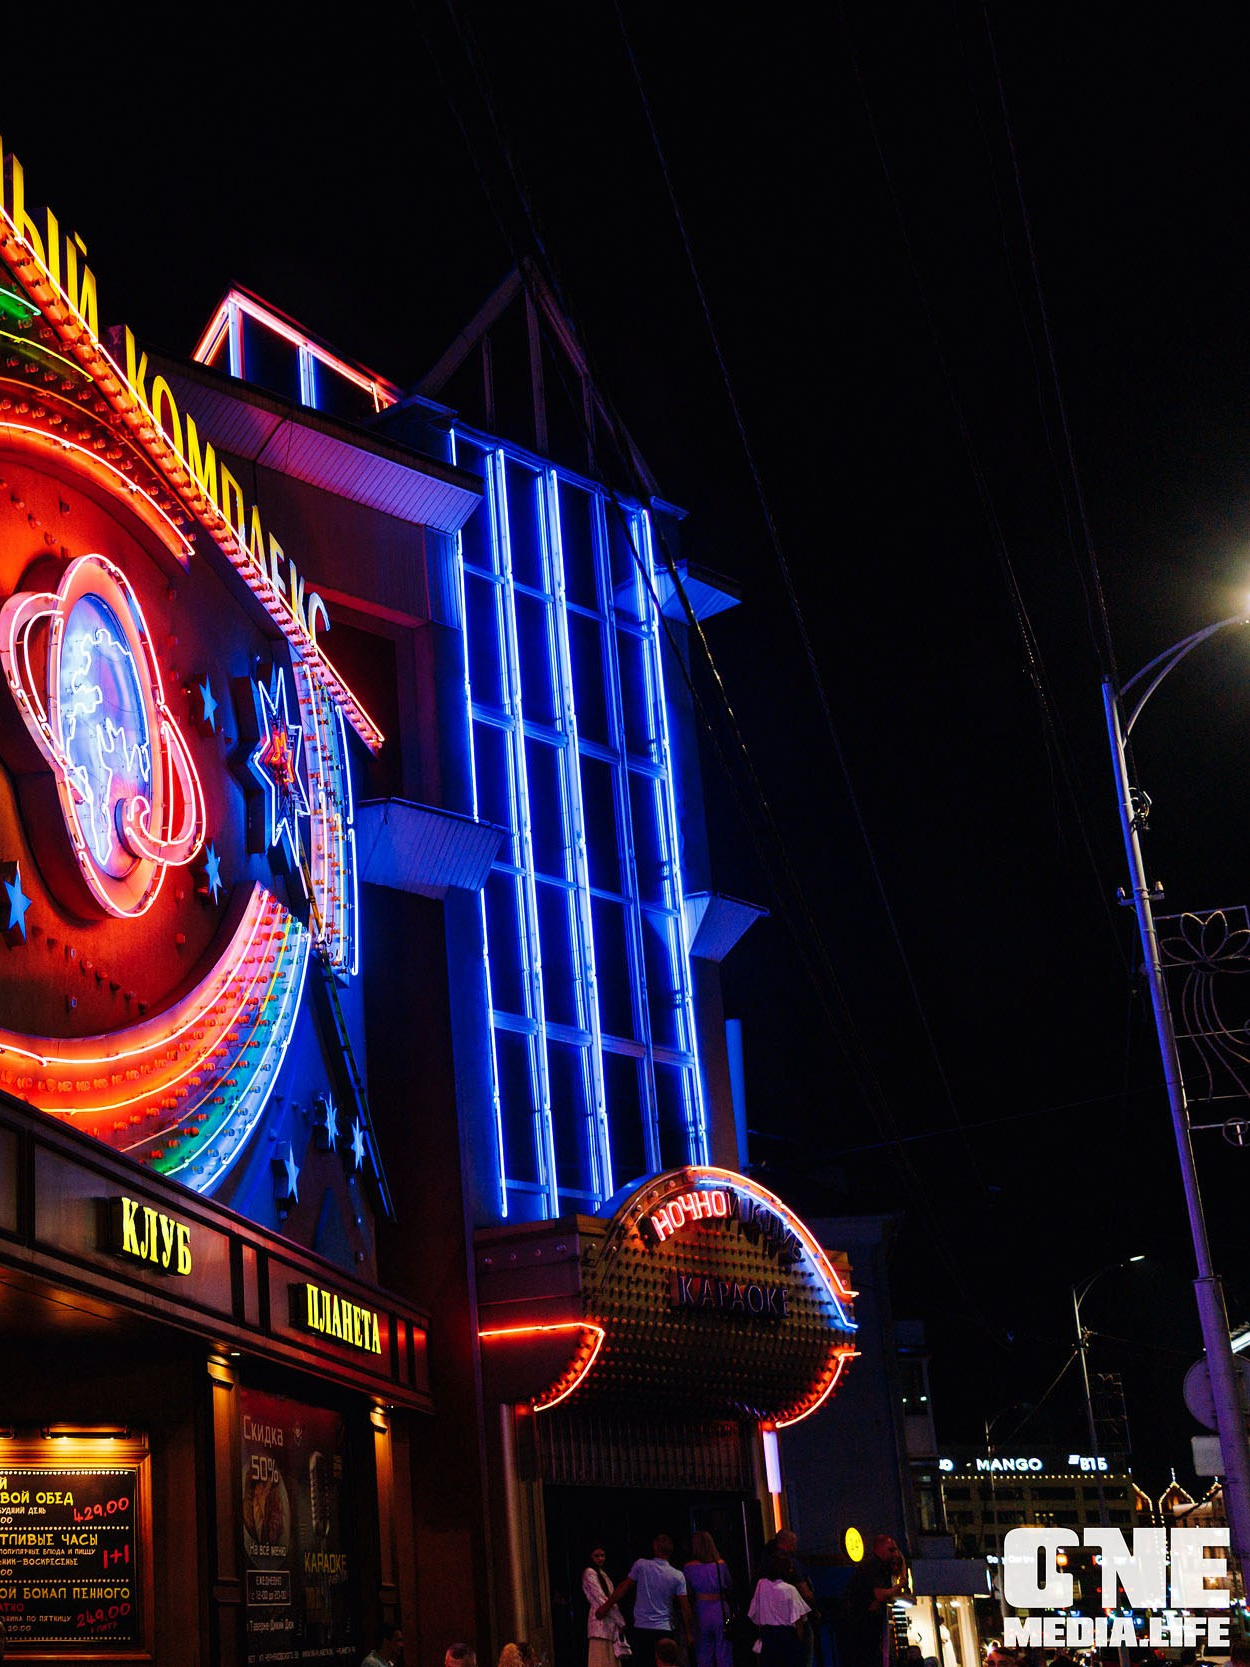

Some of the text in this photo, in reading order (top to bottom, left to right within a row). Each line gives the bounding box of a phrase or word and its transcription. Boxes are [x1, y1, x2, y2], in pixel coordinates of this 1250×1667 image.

[121, 1197, 192, 1277] КЛУБ
[306, 1283, 382, 1355] ПЛАНЕТА
[678, 1274, 791, 1318] КАРАОКЕ
[243, 1415, 284, 1448] Скидка
[251, 1455, 279, 1483] 50%
[976, 1458, 1043, 1472] MANGO
[36, 1492, 74, 1506] ОБЕД
[28, 1507, 47, 1515] ДЕНЬ
[61, 1533, 98, 1546] ЧАСЫ
[74, 1548, 96, 1556] ПИЦЦУ
[103, 1543, 129, 1569] 1+1
[303, 1551, 348, 1573] КАРАОКЕ
[23, 1587, 67, 1599] БОКАЛ
[73, 1587, 130, 1599] ПЕННОГО
[26, 1615, 36, 1623] ПО
[39, 1615, 72, 1623] ПЯТНИЦУ
